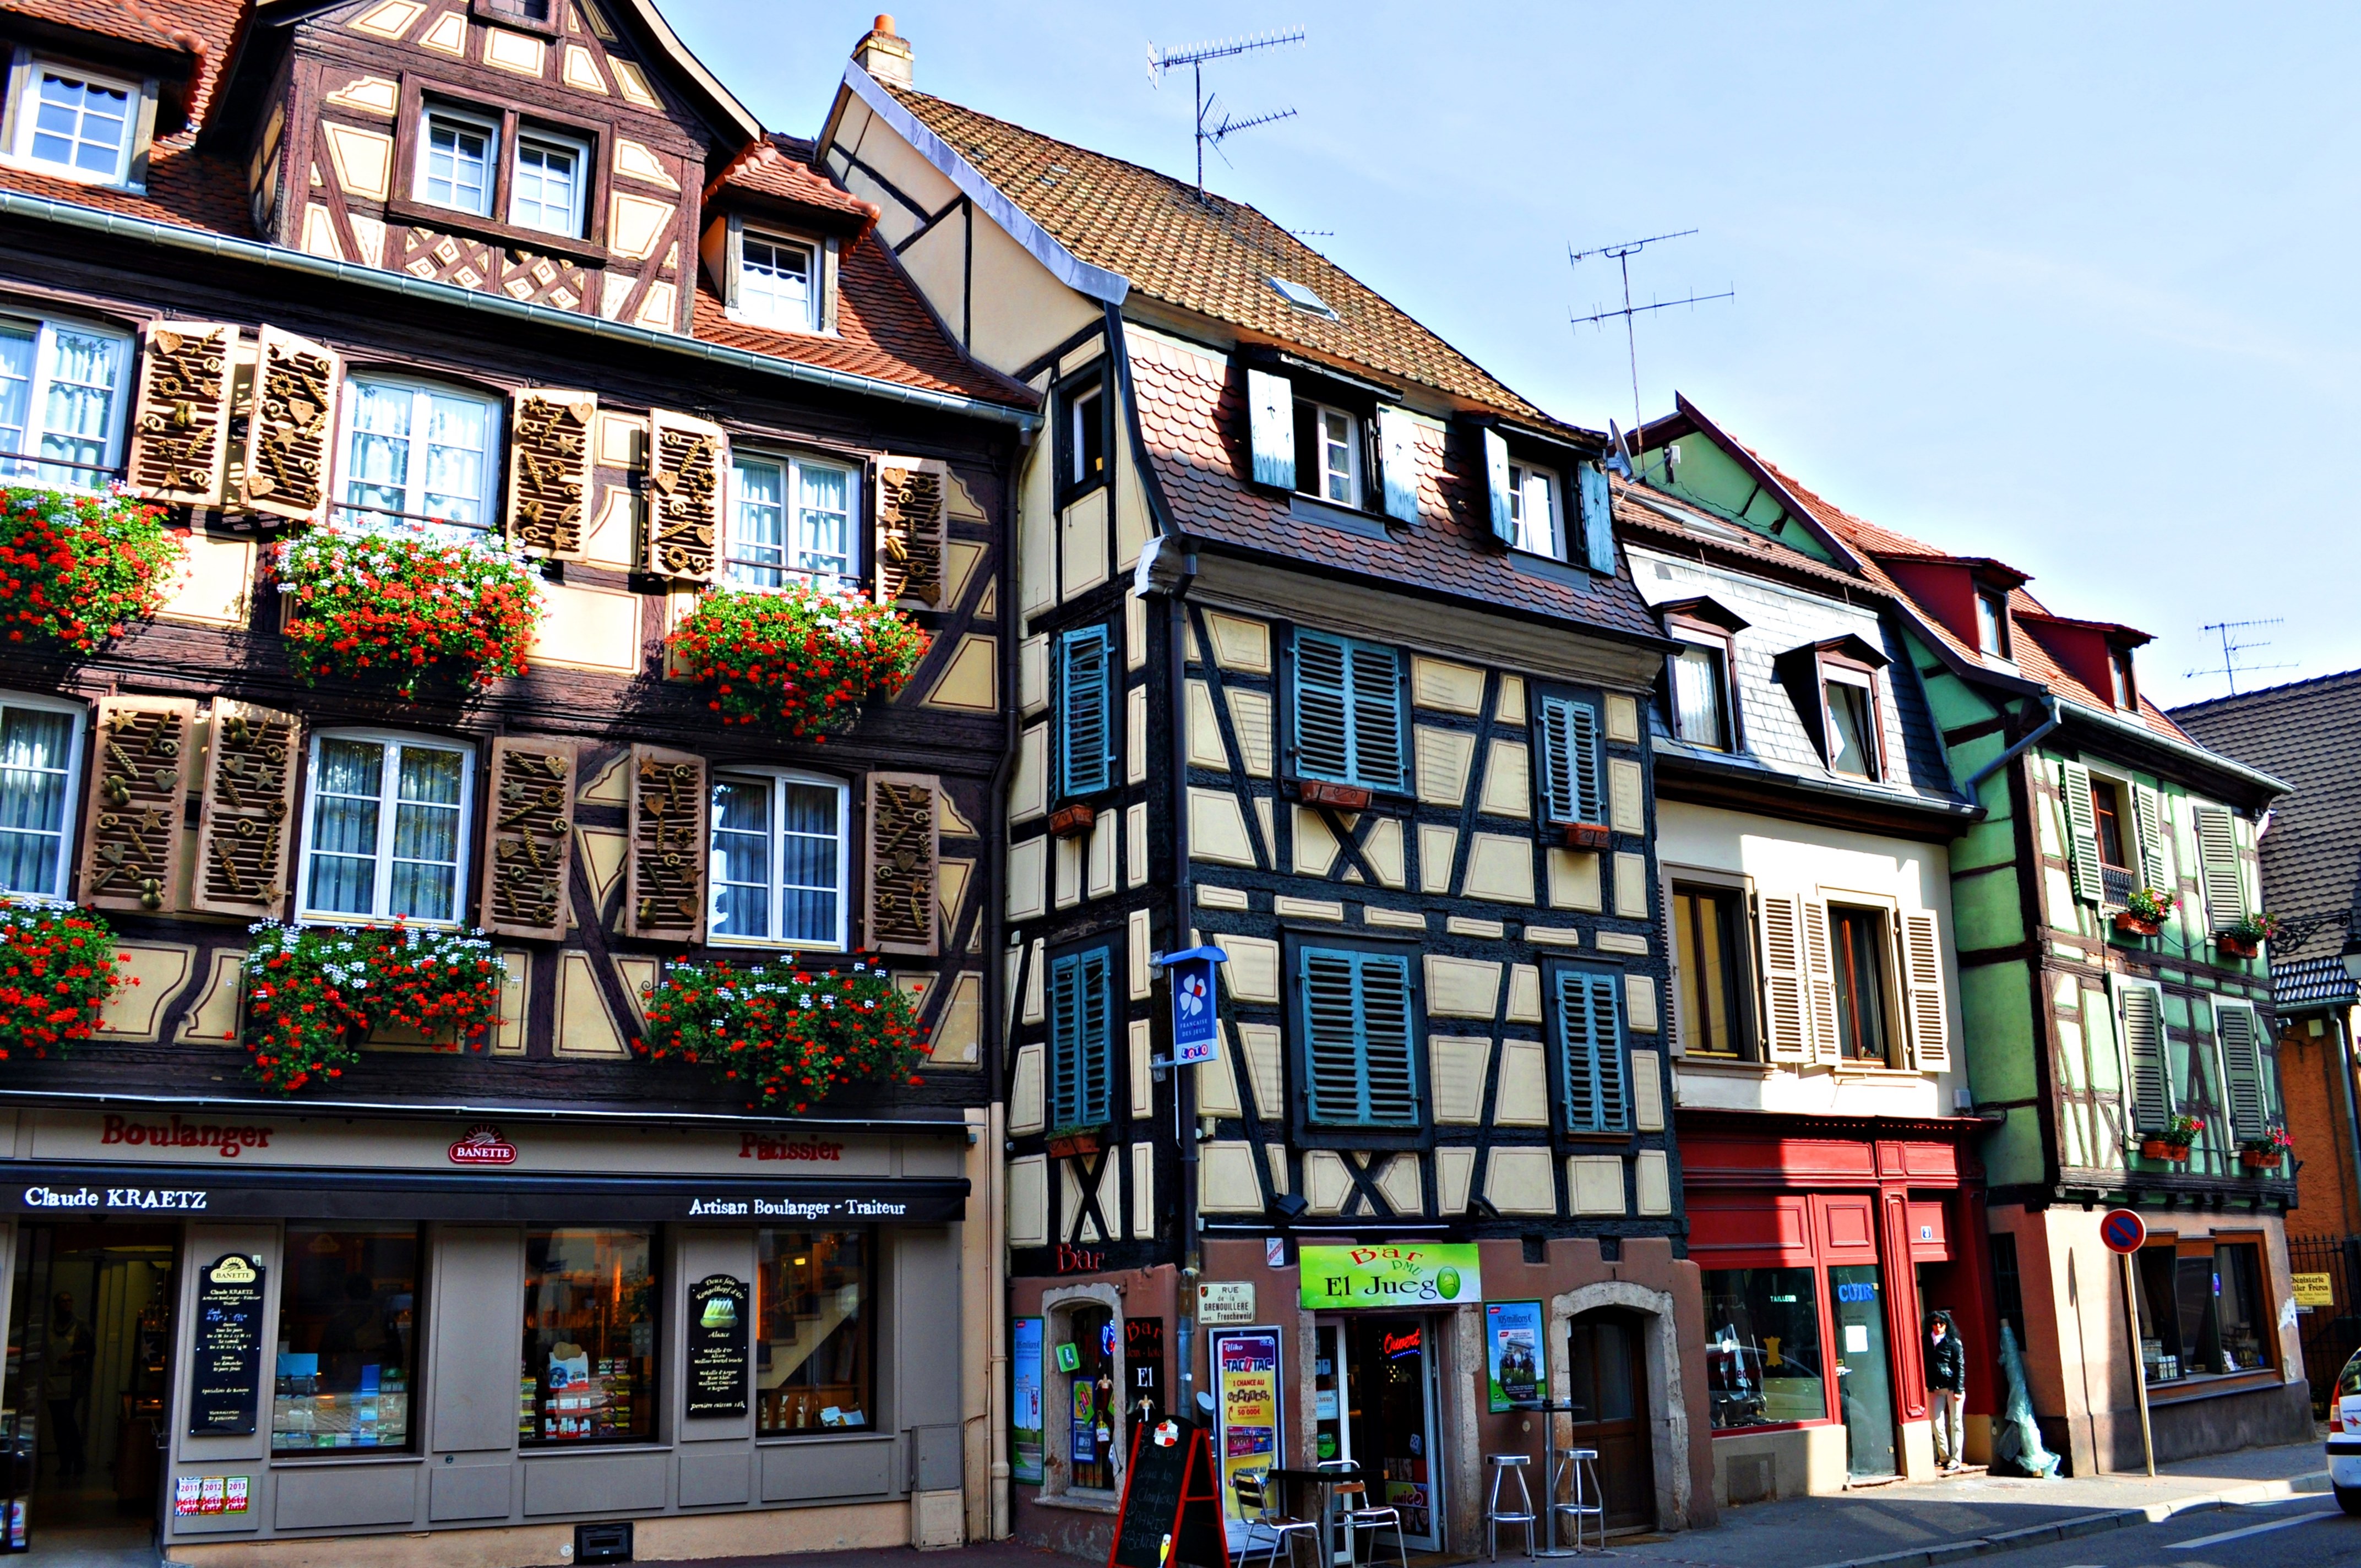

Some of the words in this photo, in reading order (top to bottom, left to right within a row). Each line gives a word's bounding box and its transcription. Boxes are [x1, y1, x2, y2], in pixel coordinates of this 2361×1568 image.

[1193, 1027, 1206, 1036] JEUX
[1181, 1044, 1208, 1059] LOTO
[101, 1114, 273, 1157] Boulanger
[456, 1147, 510, 1157] BANETTE
[739, 1131, 844, 1161] Pâtissier
[25, 1187, 99, 1206] Claude
[107, 1189, 207, 1209] KRAETZ
[689, 1199, 748, 1215] Artisan
[754, 1199, 830, 1219] Boulanger
[845, 1199, 906, 1215] Traiteur
[1056, 1243, 1105, 1273] Bar
[1348, 1248, 1423, 1266] Bar
[1391, 1260, 1423, 1276] PMU
[723, 1277, 736, 1286] fois
[1325, 1275, 1352, 1297] El
[1838, 1283, 1875, 1303] CUIR
[1204, 1302, 1248, 1311] GRENOUILLERE
[1126, 1321, 1162, 1342] Bar
[1385, 1329, 1421, 1354] Ouvert
[1136, 1366, 1154, 1387] El
